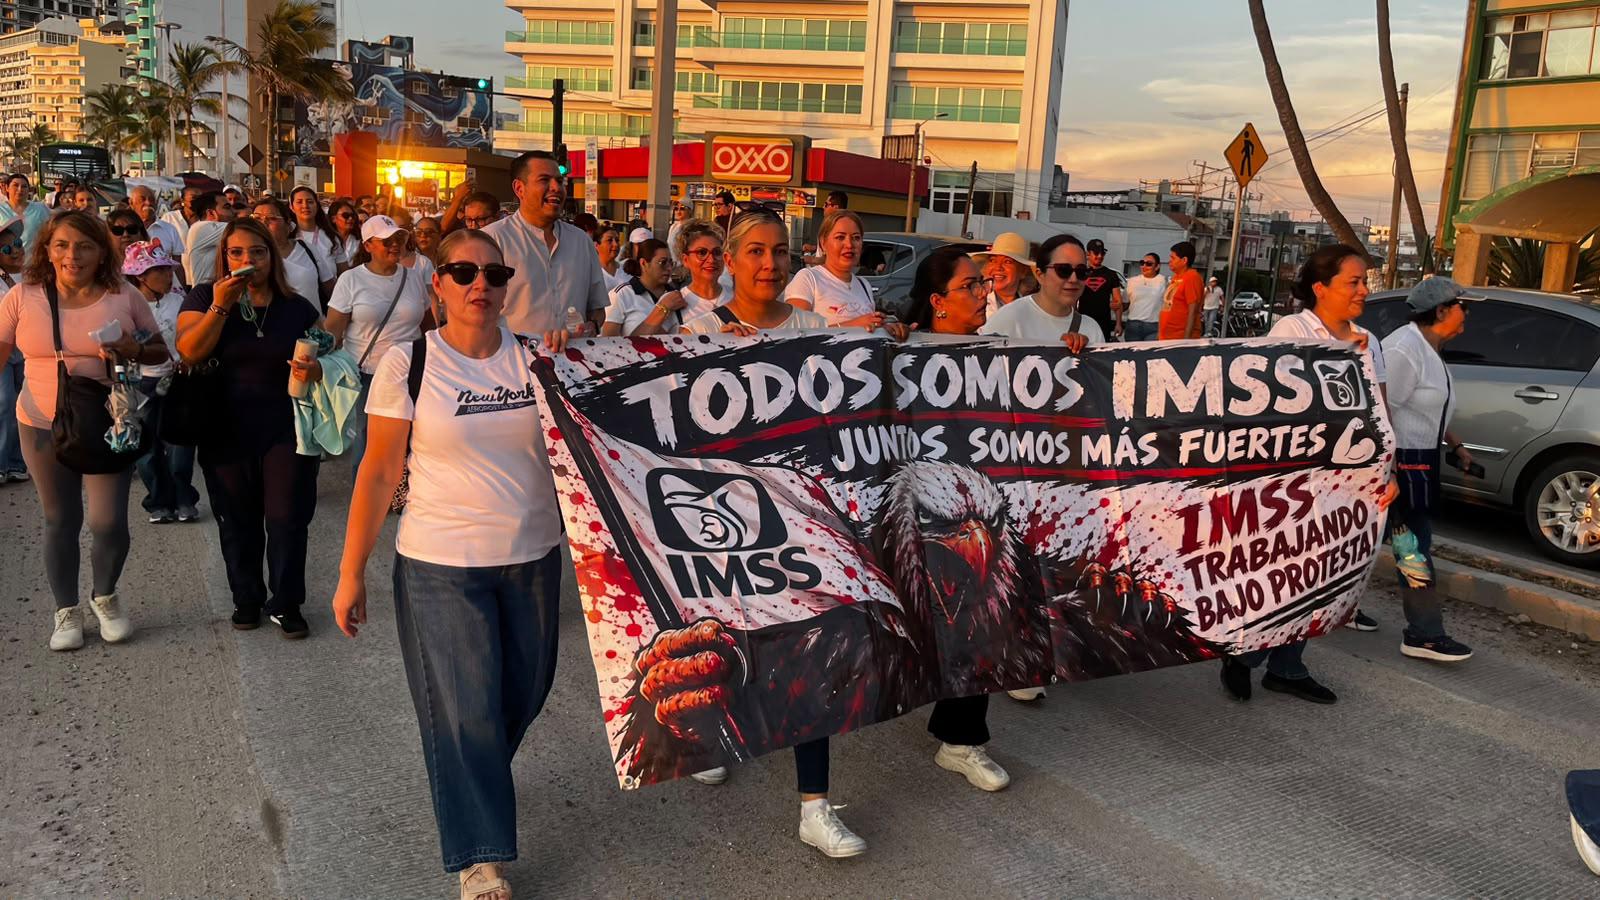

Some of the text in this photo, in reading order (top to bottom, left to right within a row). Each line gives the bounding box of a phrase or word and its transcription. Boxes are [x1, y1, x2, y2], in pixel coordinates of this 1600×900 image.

[714, 143, 789, 175] OXXO
[456, 382, 536, 405] New York
[617, 347, 1314, 451] TODOS SOMOS IMSS
[831, 422, 1327, 474] JUNTOS SOMOS MÁS FUERTES
[1174, 472, 1316, 558] IMSS
[1183, 499, 1369, 592] TRABAJANDO
[666, 546, 822, 599] IMSS
[1195, 521, 1378, 632] BAJO PROTESTA!
